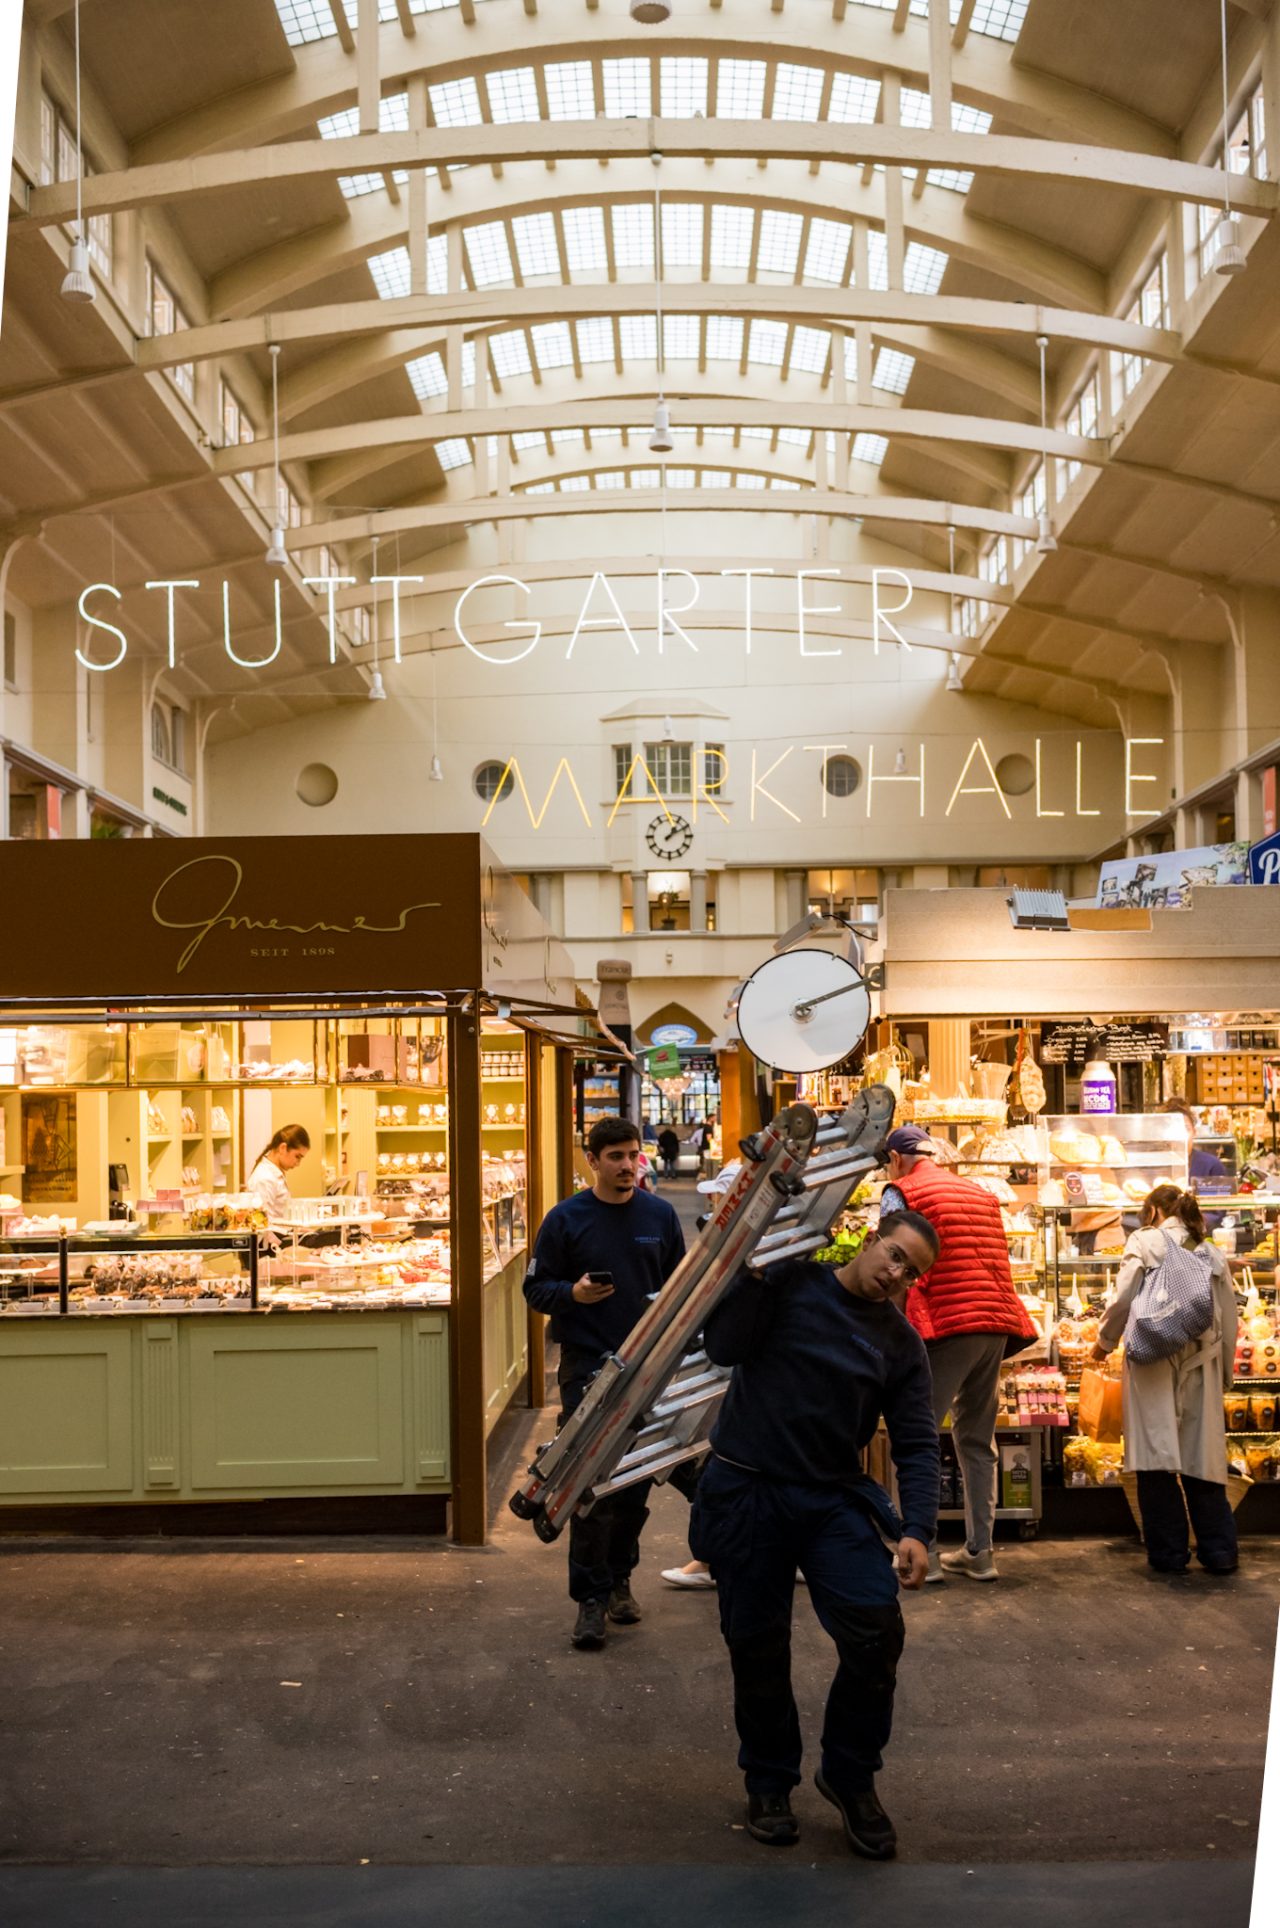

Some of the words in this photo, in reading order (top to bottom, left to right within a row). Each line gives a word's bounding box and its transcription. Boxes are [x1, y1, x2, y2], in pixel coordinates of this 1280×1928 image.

[75, 568, 914, 672] STUTTGARTER
[481, 737, 1164, 829] MARKTHALLE
[1258, 848, 1280, 884] P
[249, 948, 289, 957] SEIT
